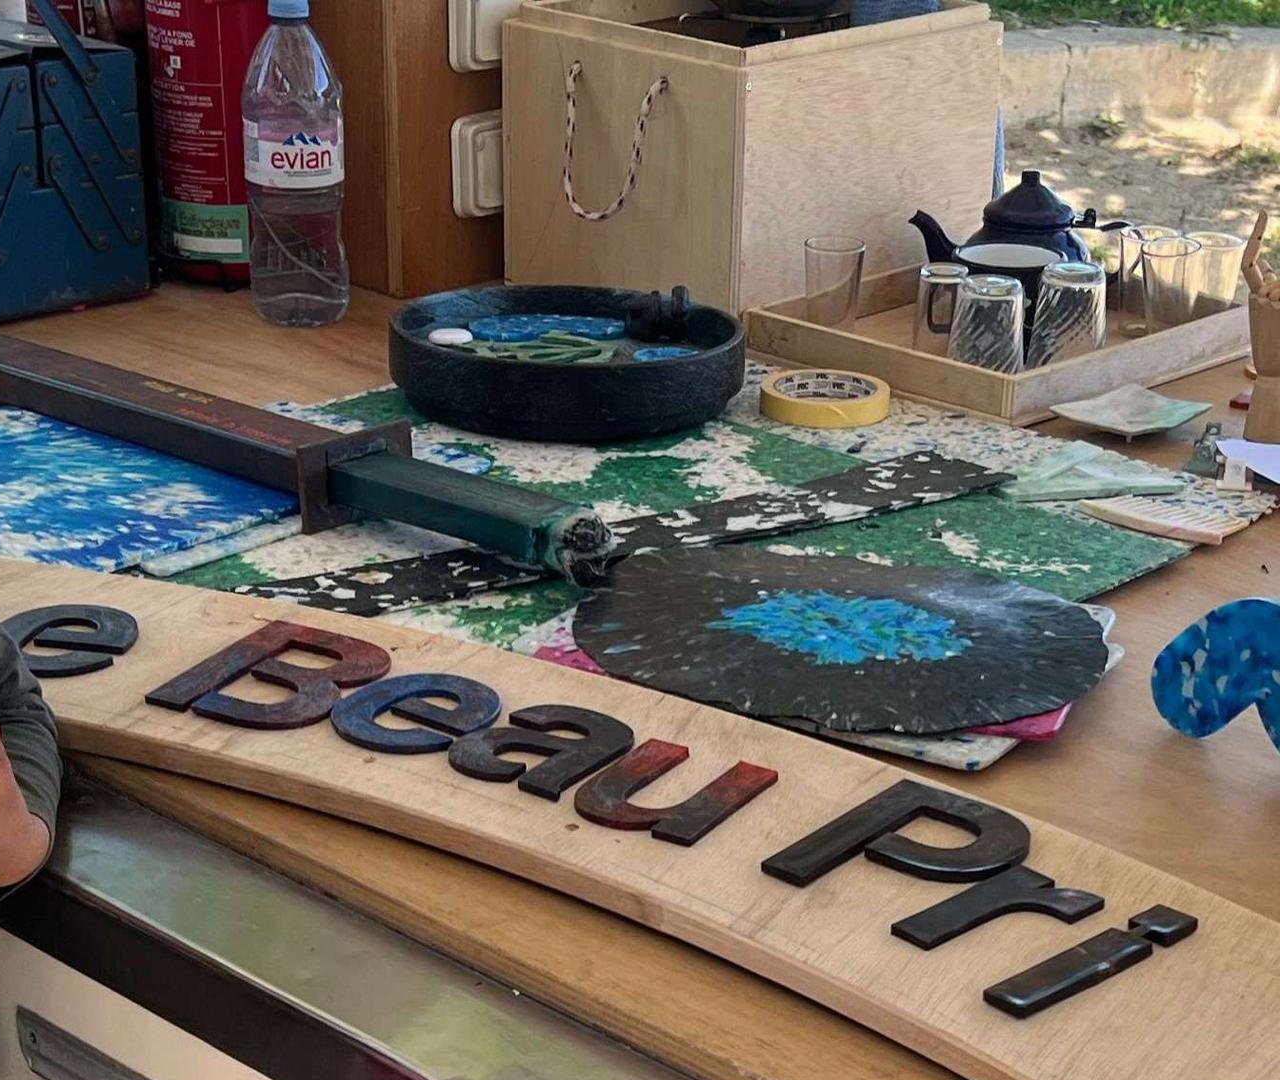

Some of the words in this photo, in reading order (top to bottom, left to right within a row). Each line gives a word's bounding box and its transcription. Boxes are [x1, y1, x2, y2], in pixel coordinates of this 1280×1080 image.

[271, 148, 331, 170] evian
[145, 620, 779, 847] Beau
[761, 778, 1198, 1019] Pri
